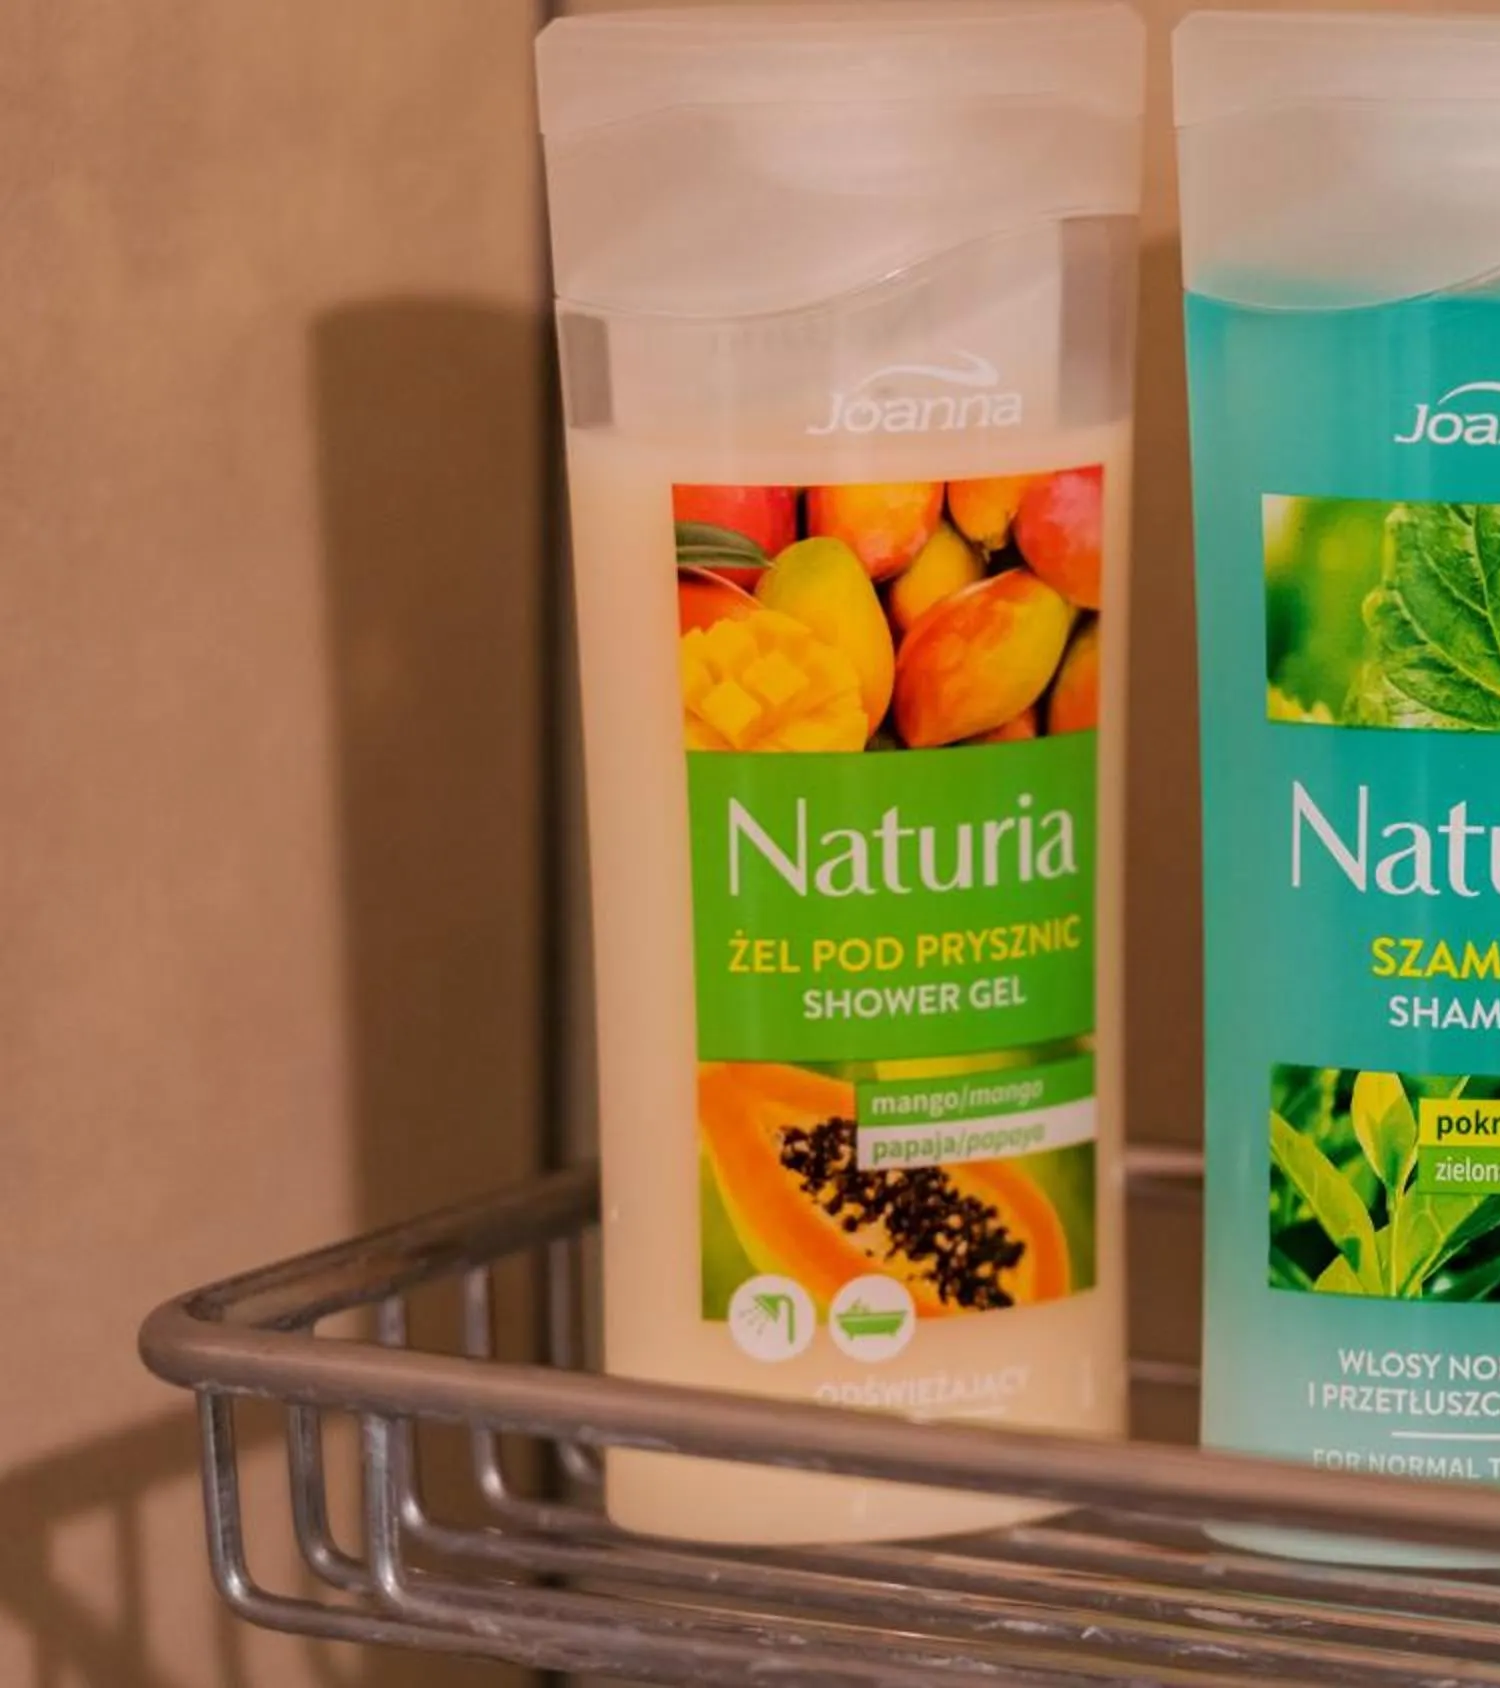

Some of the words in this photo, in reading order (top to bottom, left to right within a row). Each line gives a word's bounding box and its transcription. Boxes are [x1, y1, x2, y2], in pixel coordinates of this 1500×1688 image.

[805, 391, 1022, 434] Joanna
[728, 793, 1078, 896] Naturia
[728, 930, 800, 973] ŻEL
[812, 936, 904, 972] POD
[916, 915, 1081, 968] PRYSZNIC
[803, 982, 960, 1020] SHOWER
[969, 976, 1026, 1011] GEL
[1308, 1382, 1315, 1407] I
[1313, 1449, 1361, 1472] FOR
[1368, 1452, 1481, 1480] NORMAL
